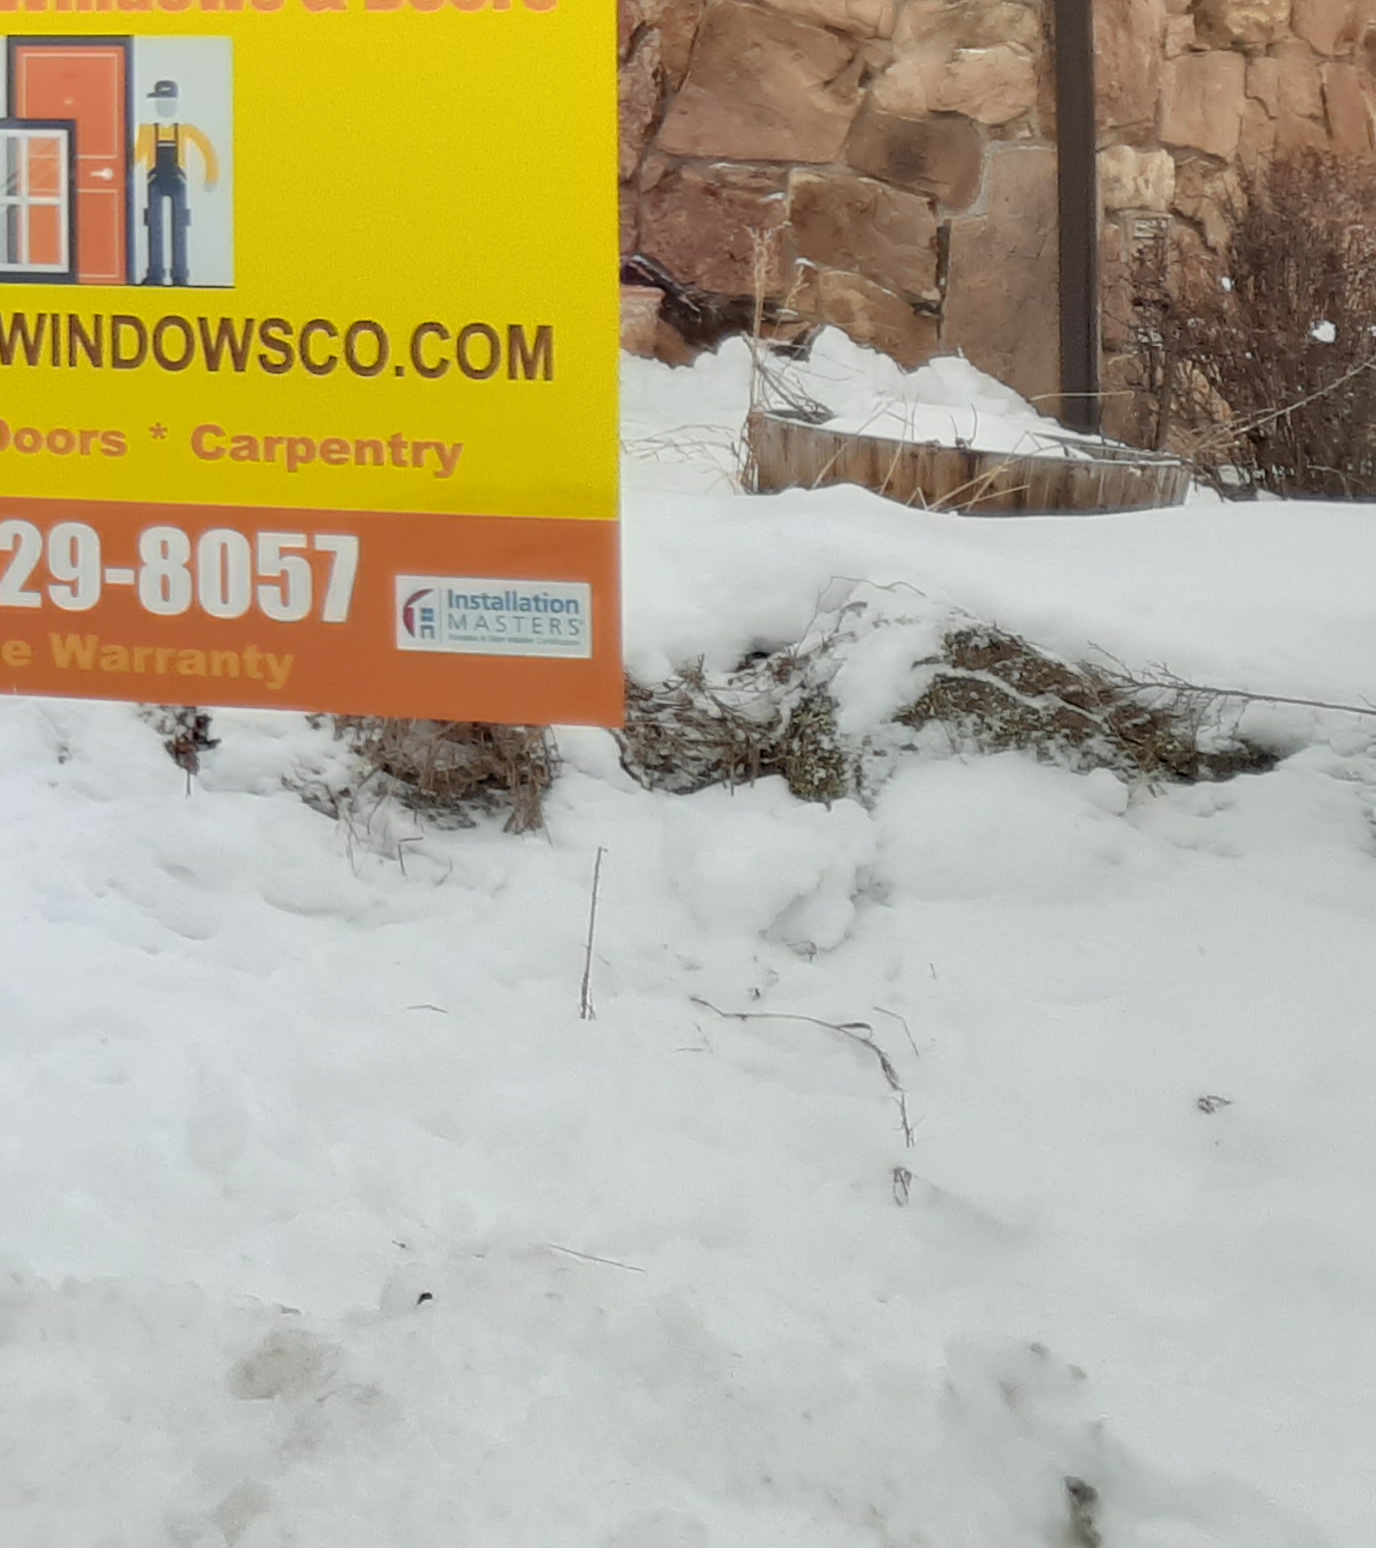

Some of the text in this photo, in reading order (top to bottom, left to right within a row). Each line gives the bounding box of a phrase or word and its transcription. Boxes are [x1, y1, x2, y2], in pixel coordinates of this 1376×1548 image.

[190, 424, 464, 479] Carpentry
[447, 588, 580, 615] Installation
[447, 613, 581, 637] MASTERS
[50, 632, 296, 689] Warranty
